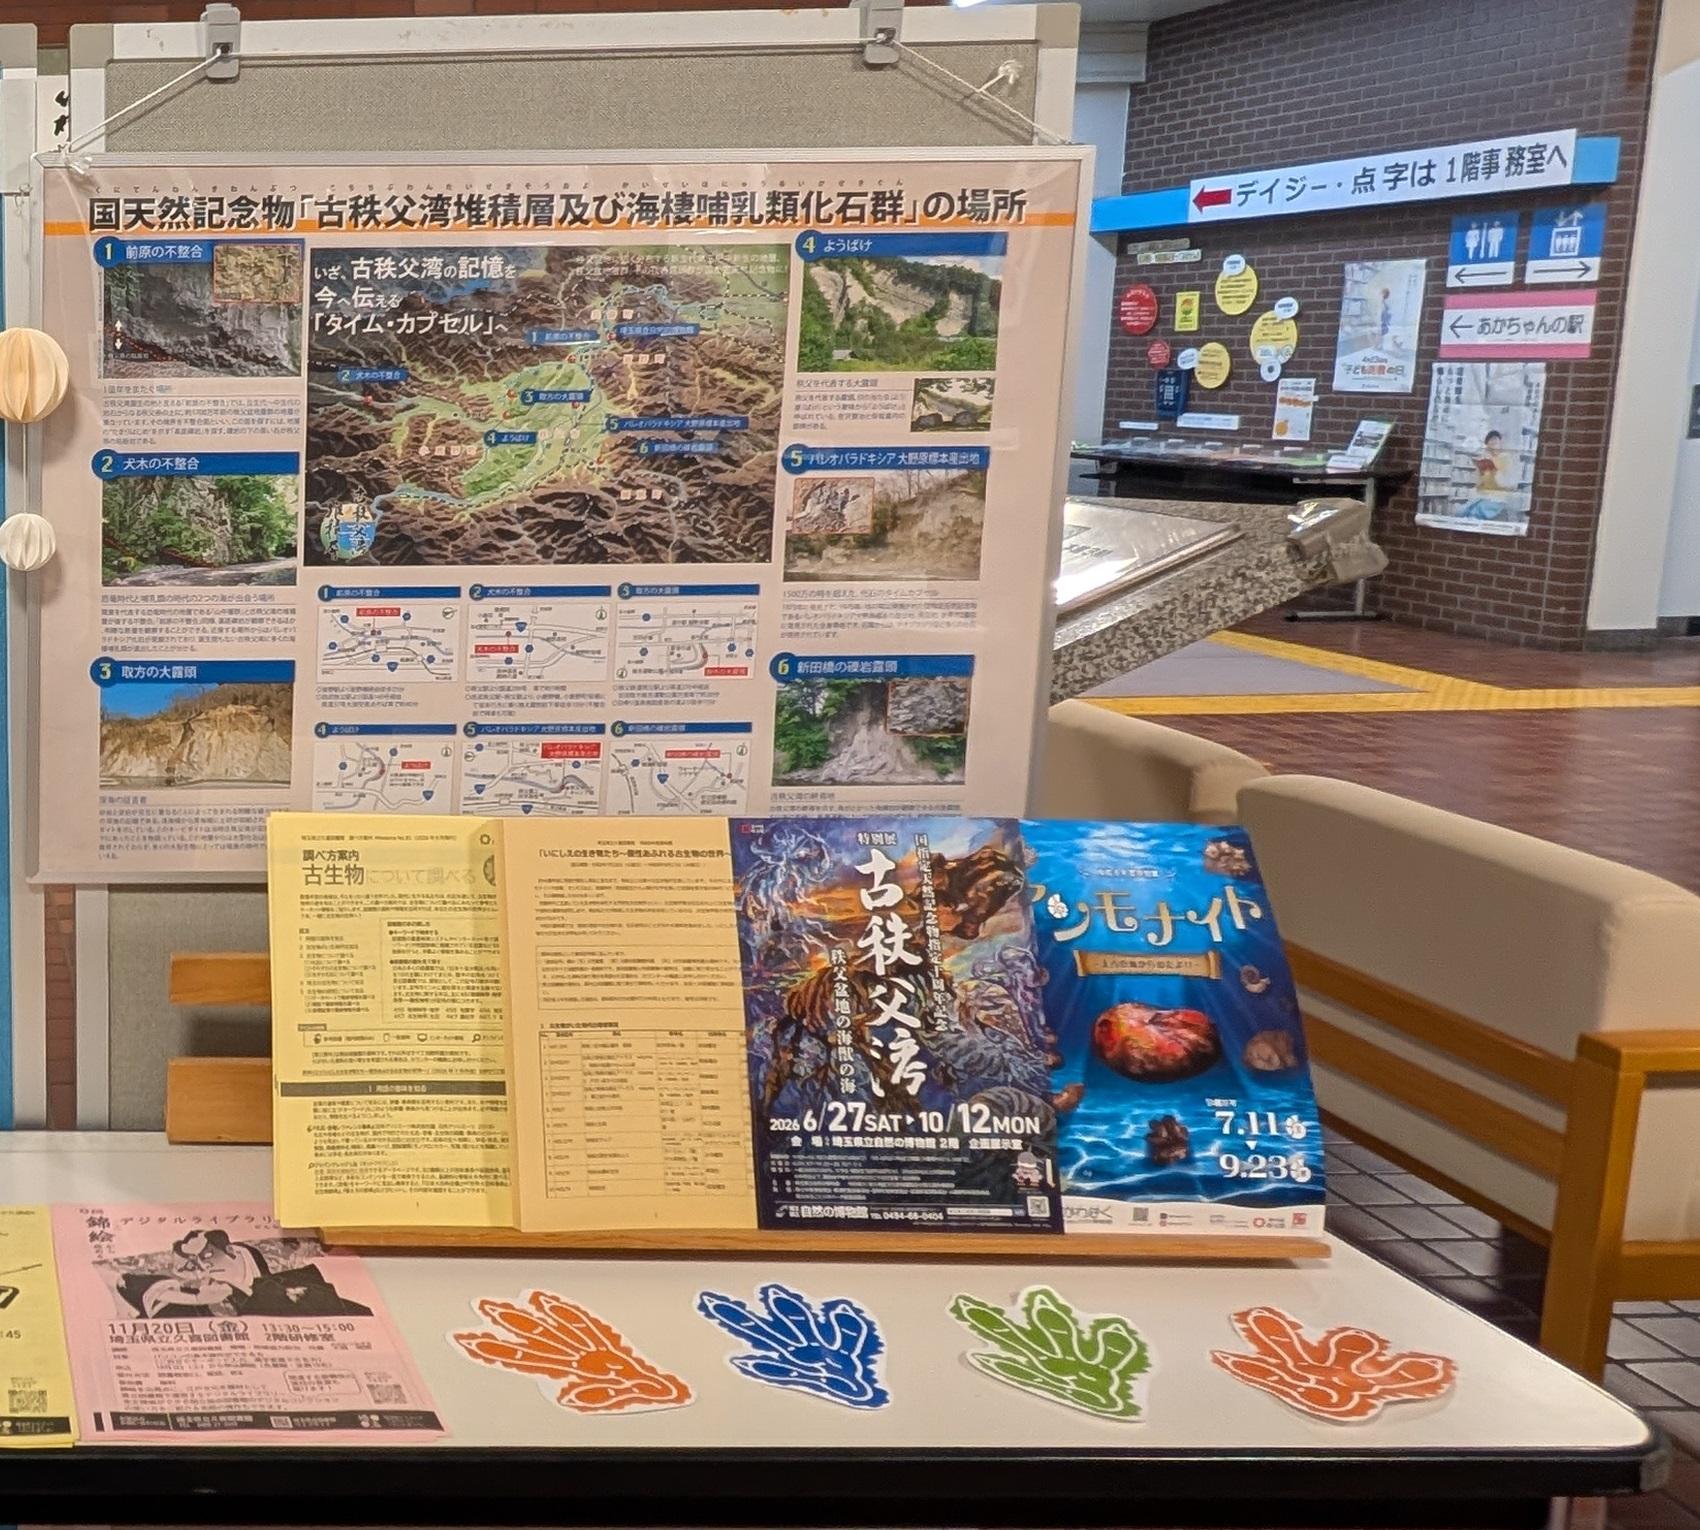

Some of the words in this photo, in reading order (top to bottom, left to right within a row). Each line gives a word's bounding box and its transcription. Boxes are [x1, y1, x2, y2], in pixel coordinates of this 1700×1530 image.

[88, 189, 1027, 232] 国天然記念物「古秩父湾堆積層及び海棲哺乳類化石群」の場所
[104, 243, 112, 260] 1
[126, 245, 204, 259] 前原の不整合
[802, 236, 816, 254] 4
[824, 239, 872, 252] ようばけ
[1476, 314, 1584, 337] あかちゃんの駅
[101, 456, 113, 473] 2
[123, 457, 200, 471] 犬木の不整合
[790, 450, 803, 467] 5
[100, 663, 112, 680] 3
[121, 665, 197, 679] 取方の大露頭
[778, 658, 789, 676] 6
[303, 849, 359, 861] 調べ方案内
[769, 1118, 800, 1132] 2026
[1214, 1110, 1280, 1136] 7.11
[1218, 1153, 1289, 1180] 9.23
[108, 1322, 195, 1335] 11月20日
